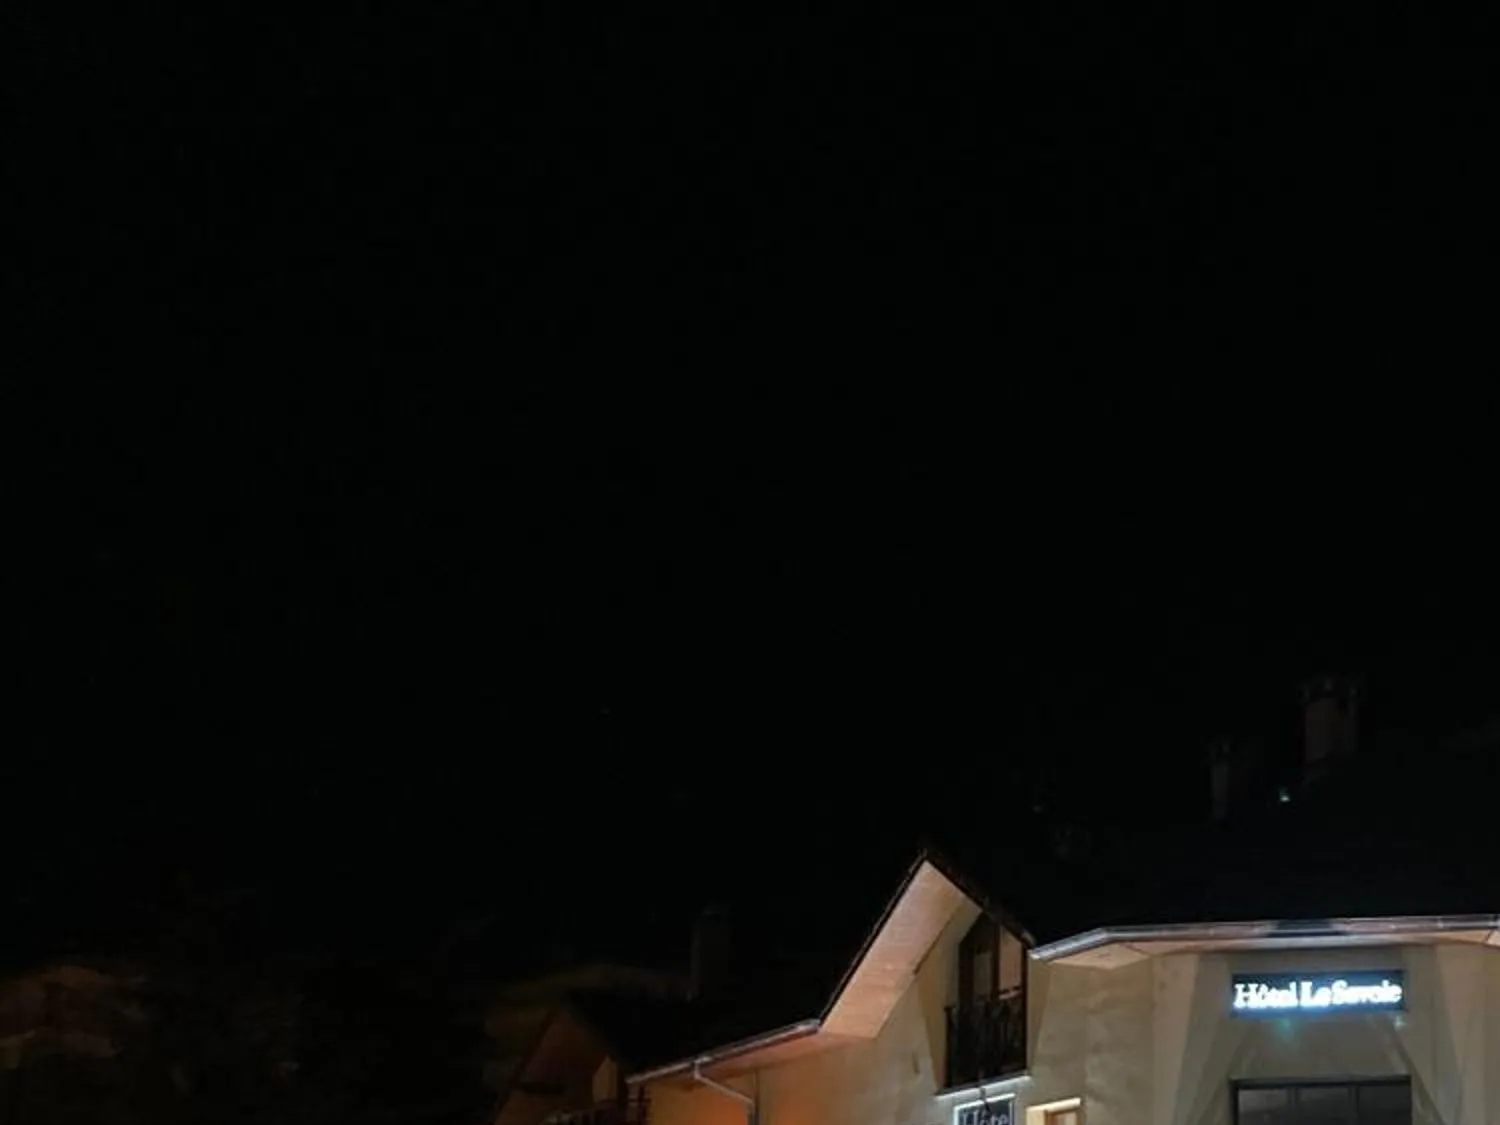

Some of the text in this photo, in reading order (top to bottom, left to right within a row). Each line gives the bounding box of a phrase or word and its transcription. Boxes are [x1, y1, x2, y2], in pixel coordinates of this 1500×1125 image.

[1233, 979, 1403, 1008] Hôtel Le Savoie
